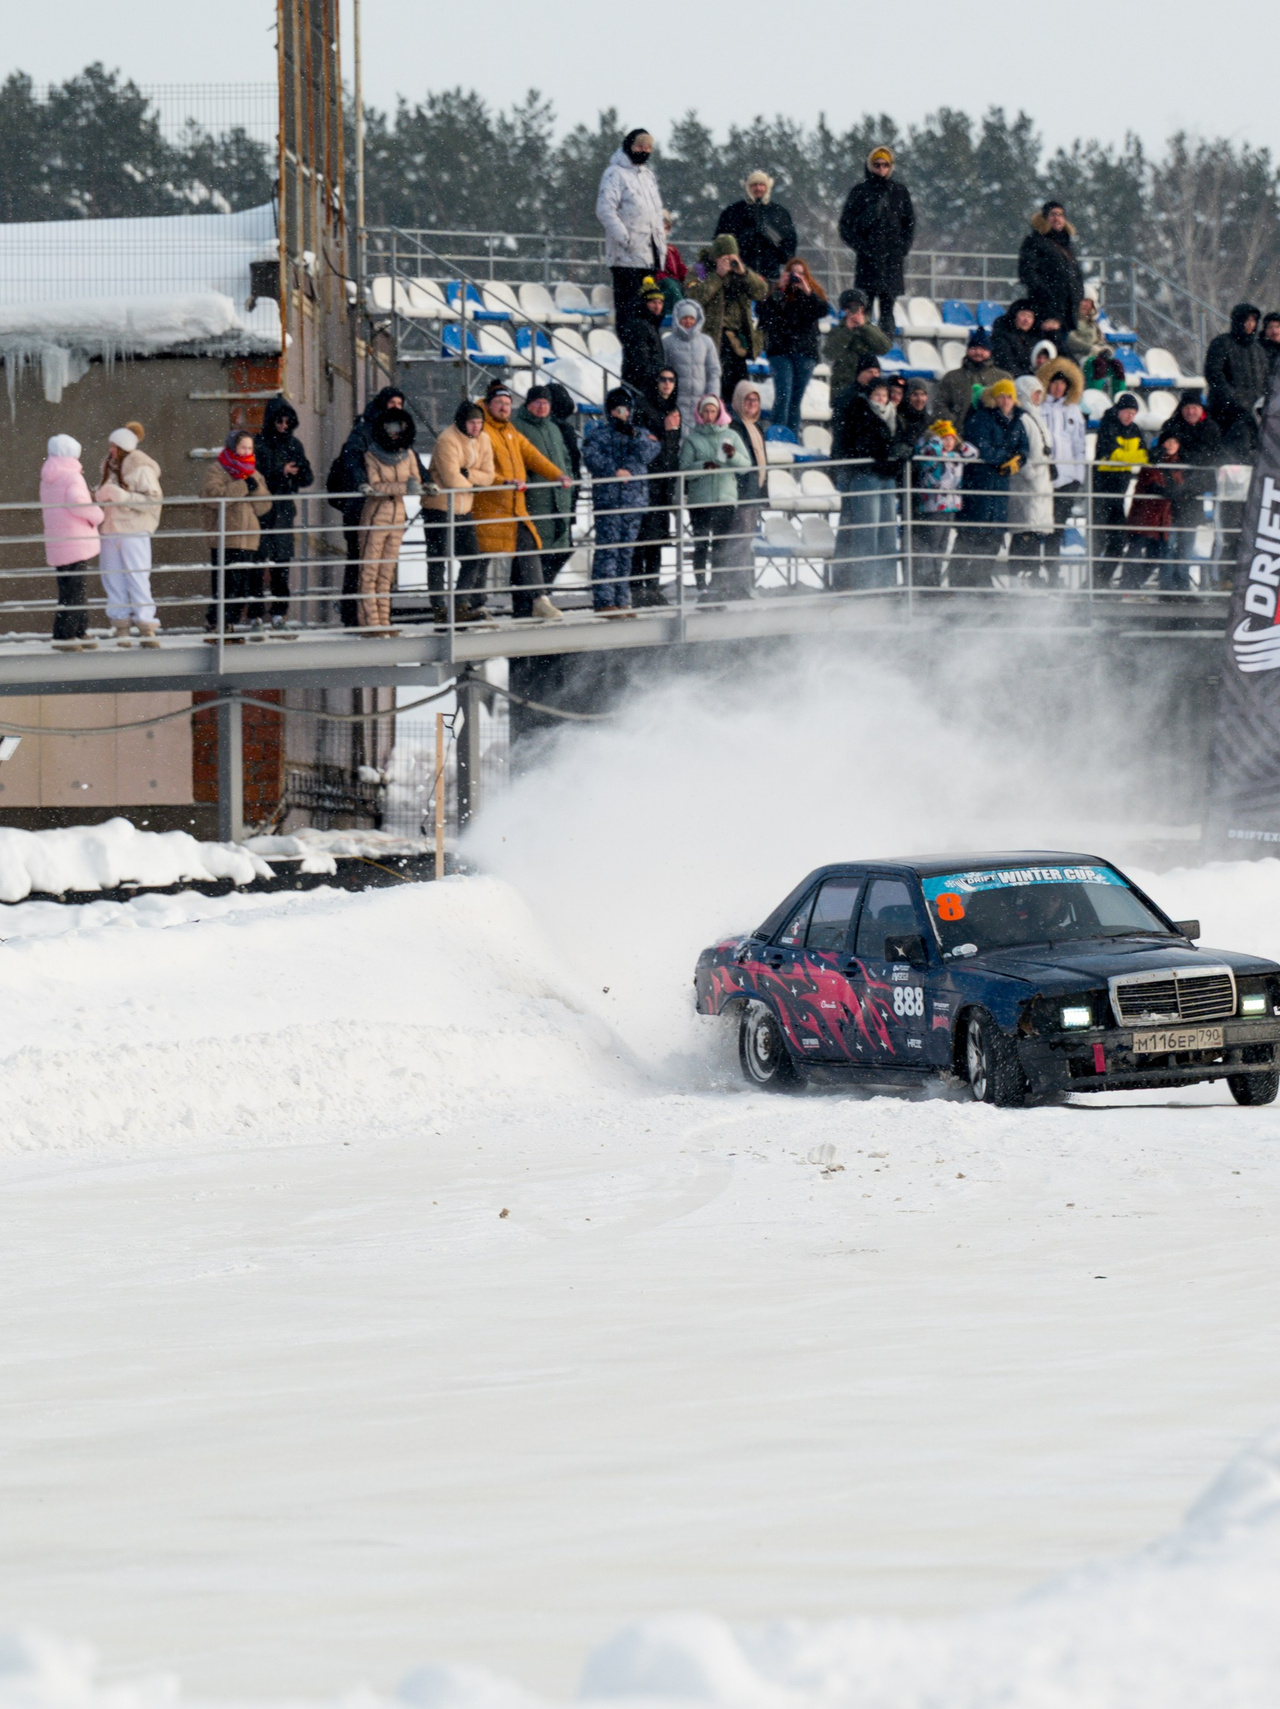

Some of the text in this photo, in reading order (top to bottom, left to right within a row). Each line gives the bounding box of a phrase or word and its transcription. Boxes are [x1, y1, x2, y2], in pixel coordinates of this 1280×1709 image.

[967, 874, 997, 885] DRIFT
[997, 868, 1098, 884] WINTER CUP
[935, 892, 966, 921] 8
[893, 986, 924, 1017] 888
